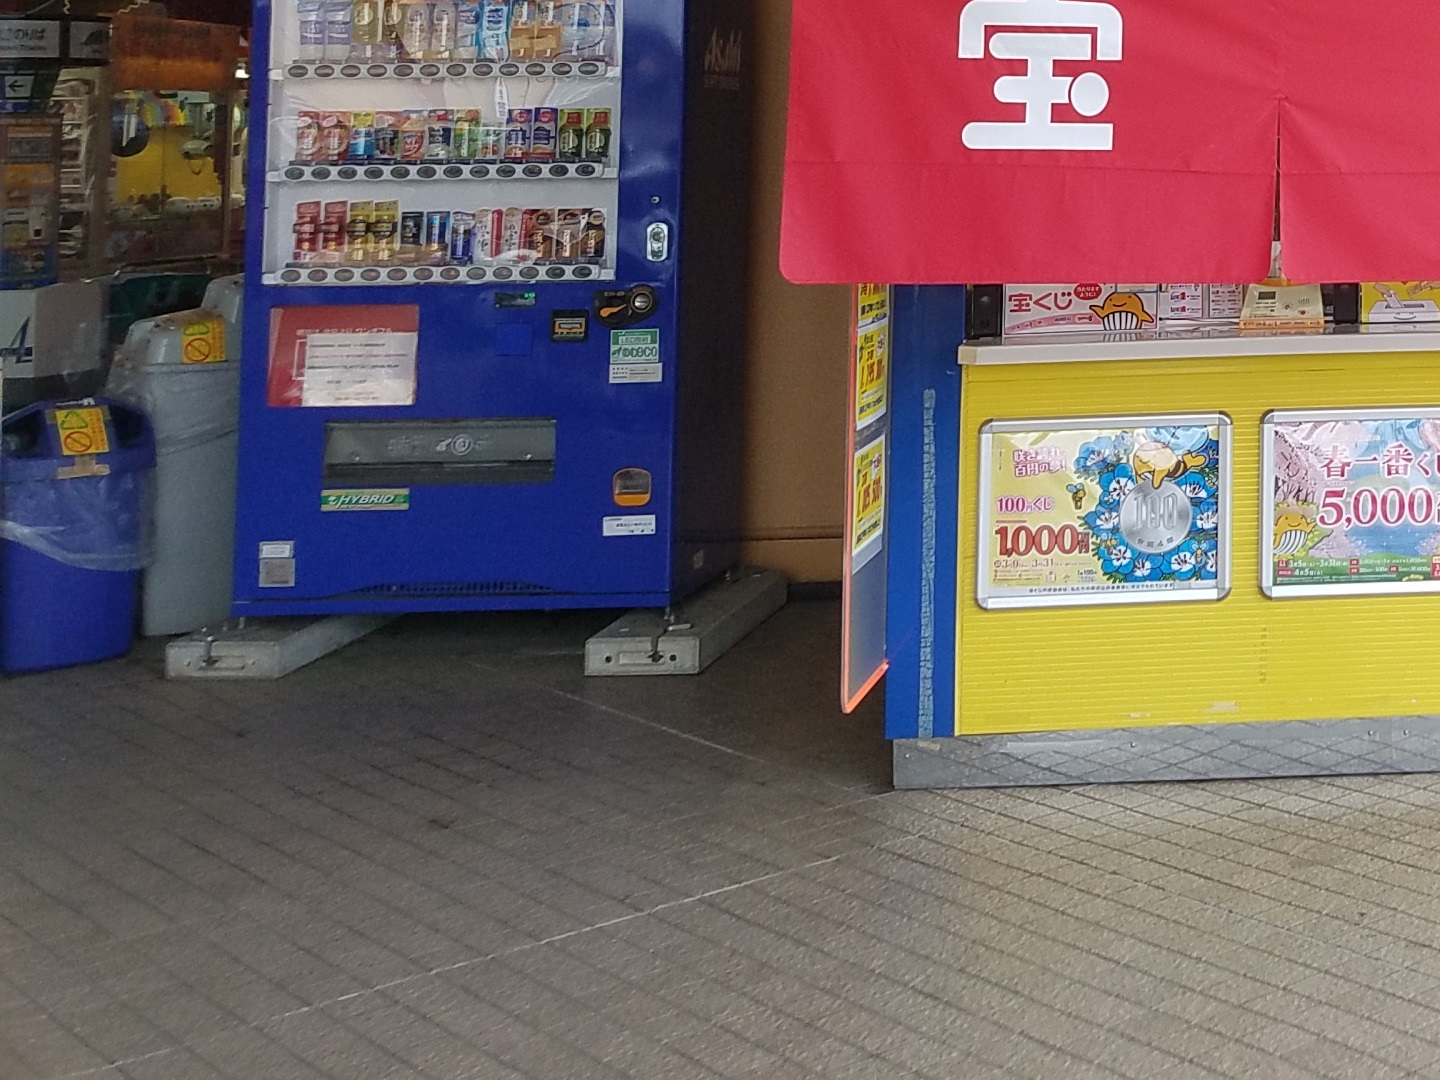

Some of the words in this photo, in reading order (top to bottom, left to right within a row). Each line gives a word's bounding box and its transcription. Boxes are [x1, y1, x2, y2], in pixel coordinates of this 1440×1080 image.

[1008, 292, 1073, 313] 宝くじ
[336, 494, 395, 509] HYBRID
